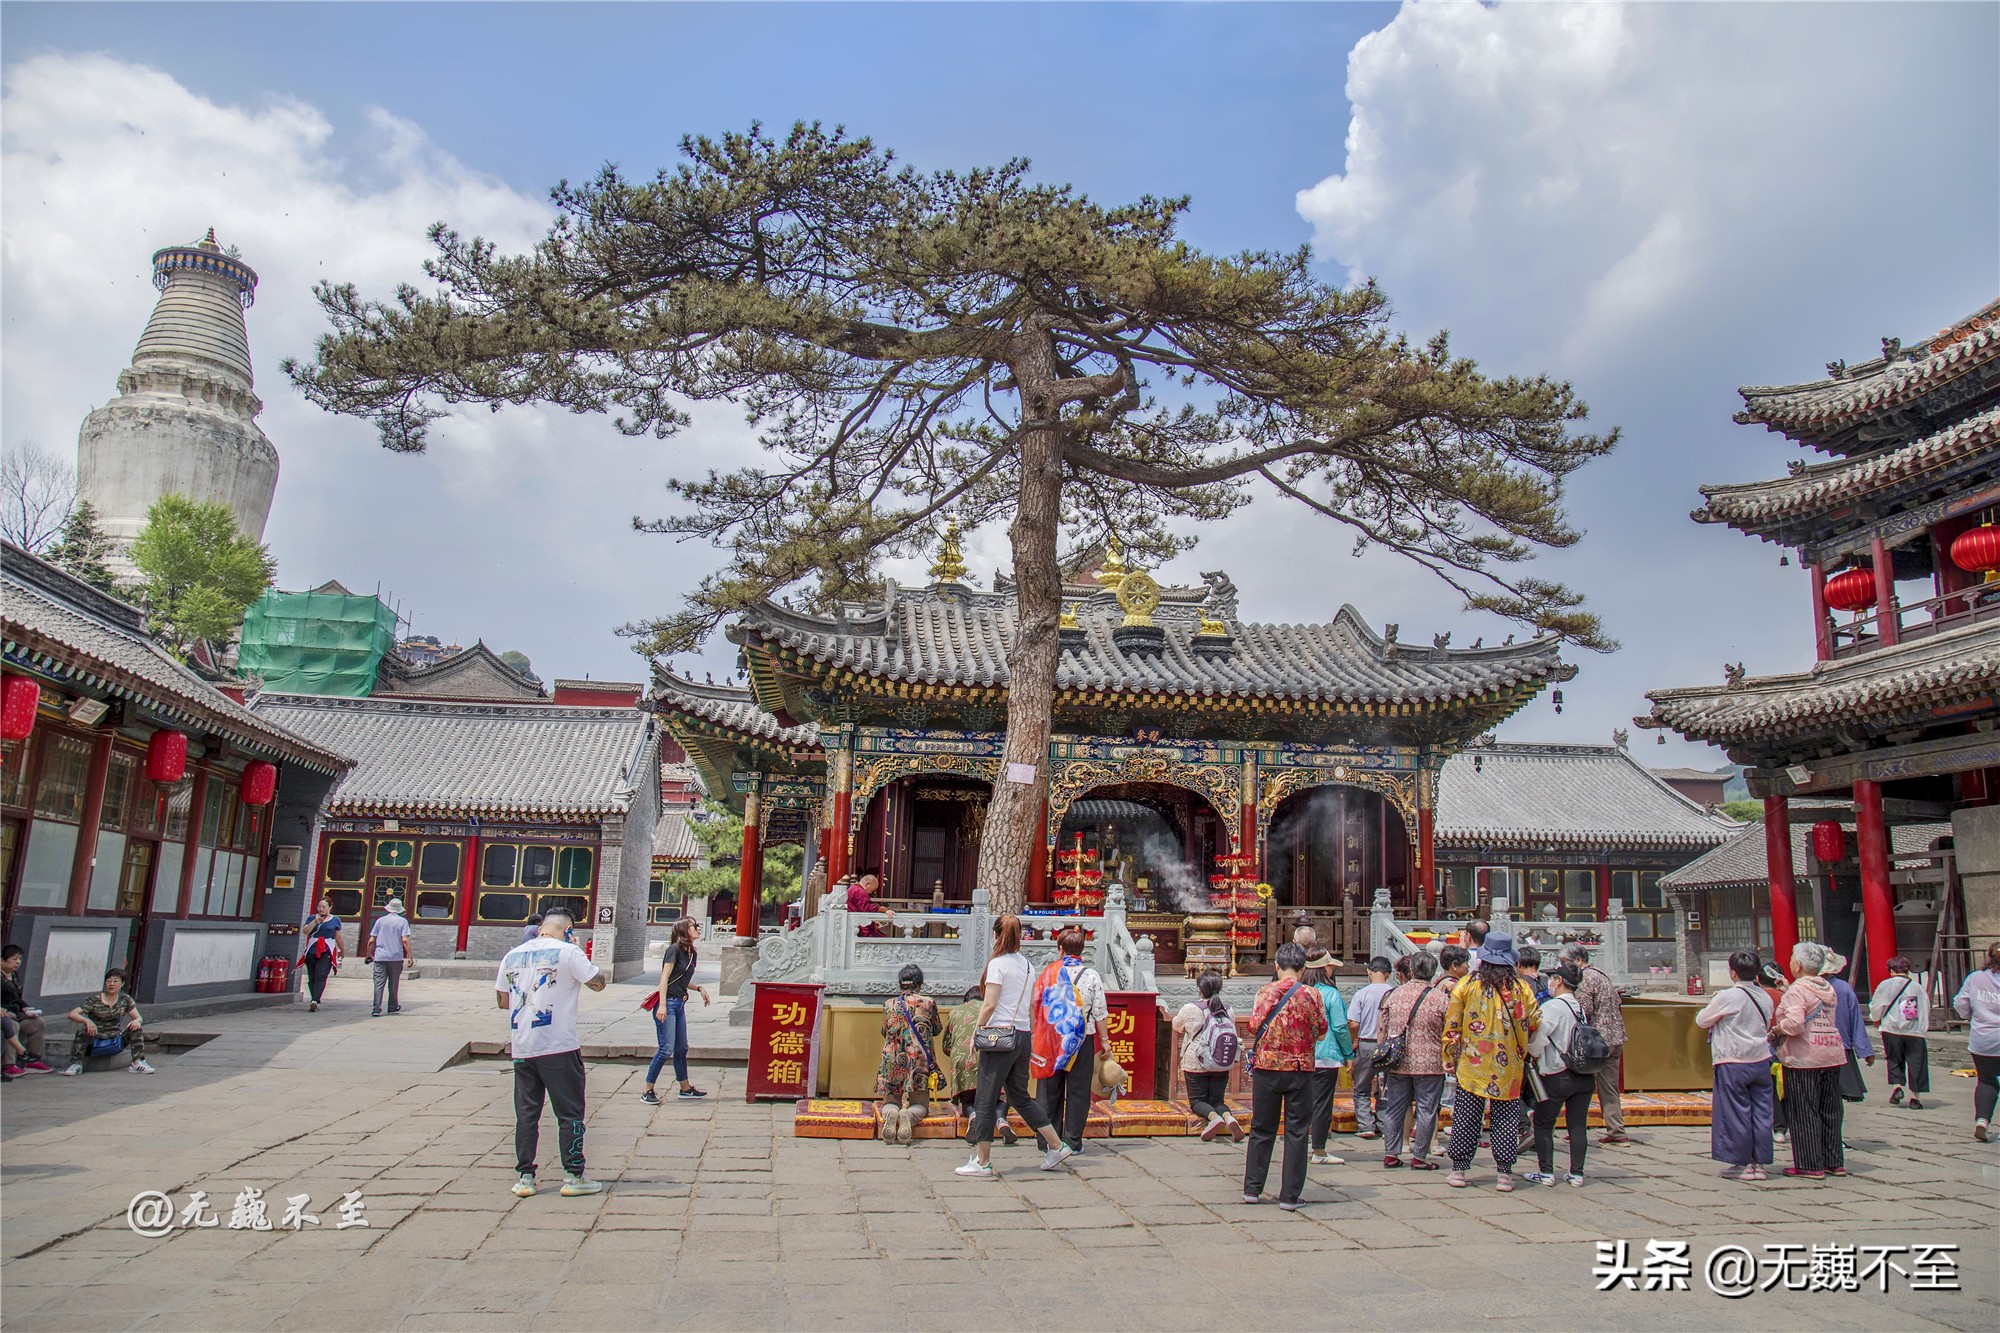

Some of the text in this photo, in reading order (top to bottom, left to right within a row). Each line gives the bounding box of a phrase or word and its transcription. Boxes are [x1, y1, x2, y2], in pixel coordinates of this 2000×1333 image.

[767, 1002, 807, 1085] 功德箱
[1106, 1010, 1135, 1093] 功德
